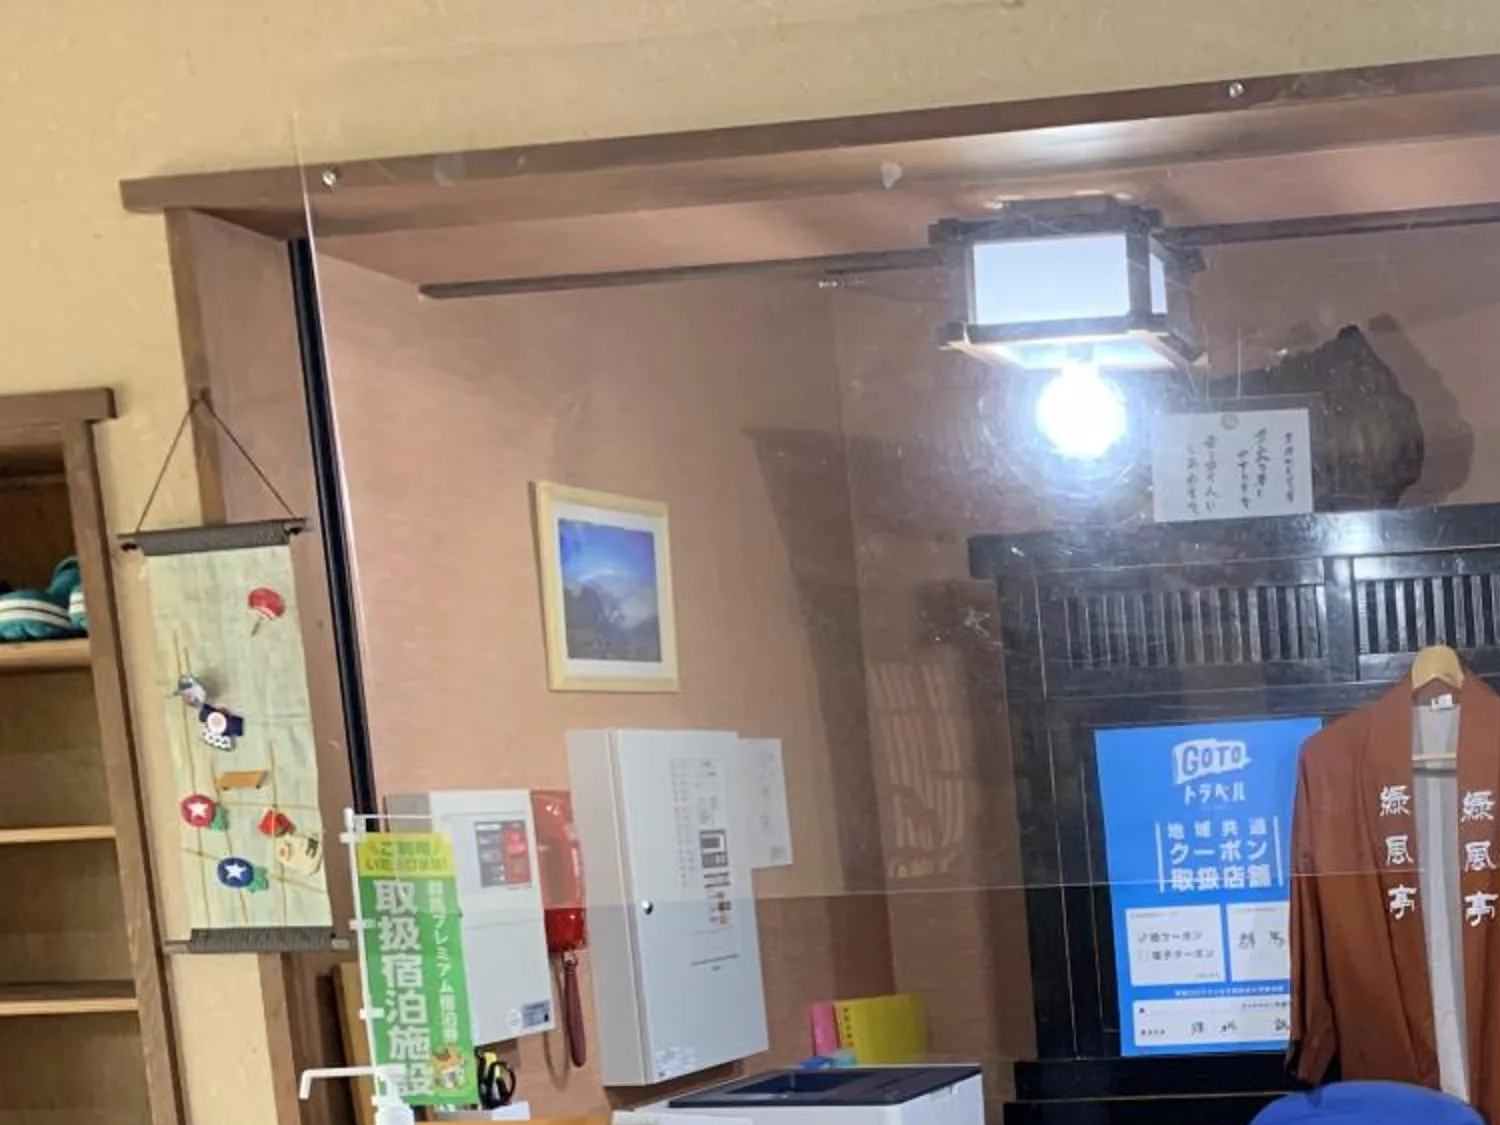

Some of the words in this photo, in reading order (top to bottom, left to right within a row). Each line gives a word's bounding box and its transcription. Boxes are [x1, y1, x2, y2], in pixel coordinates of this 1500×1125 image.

[1184, 781, 1246, 806] トラベル
[1170, 840, 1268, 865] クーポン
[374, 880, 434, 1097] 取扱宿泊施設
